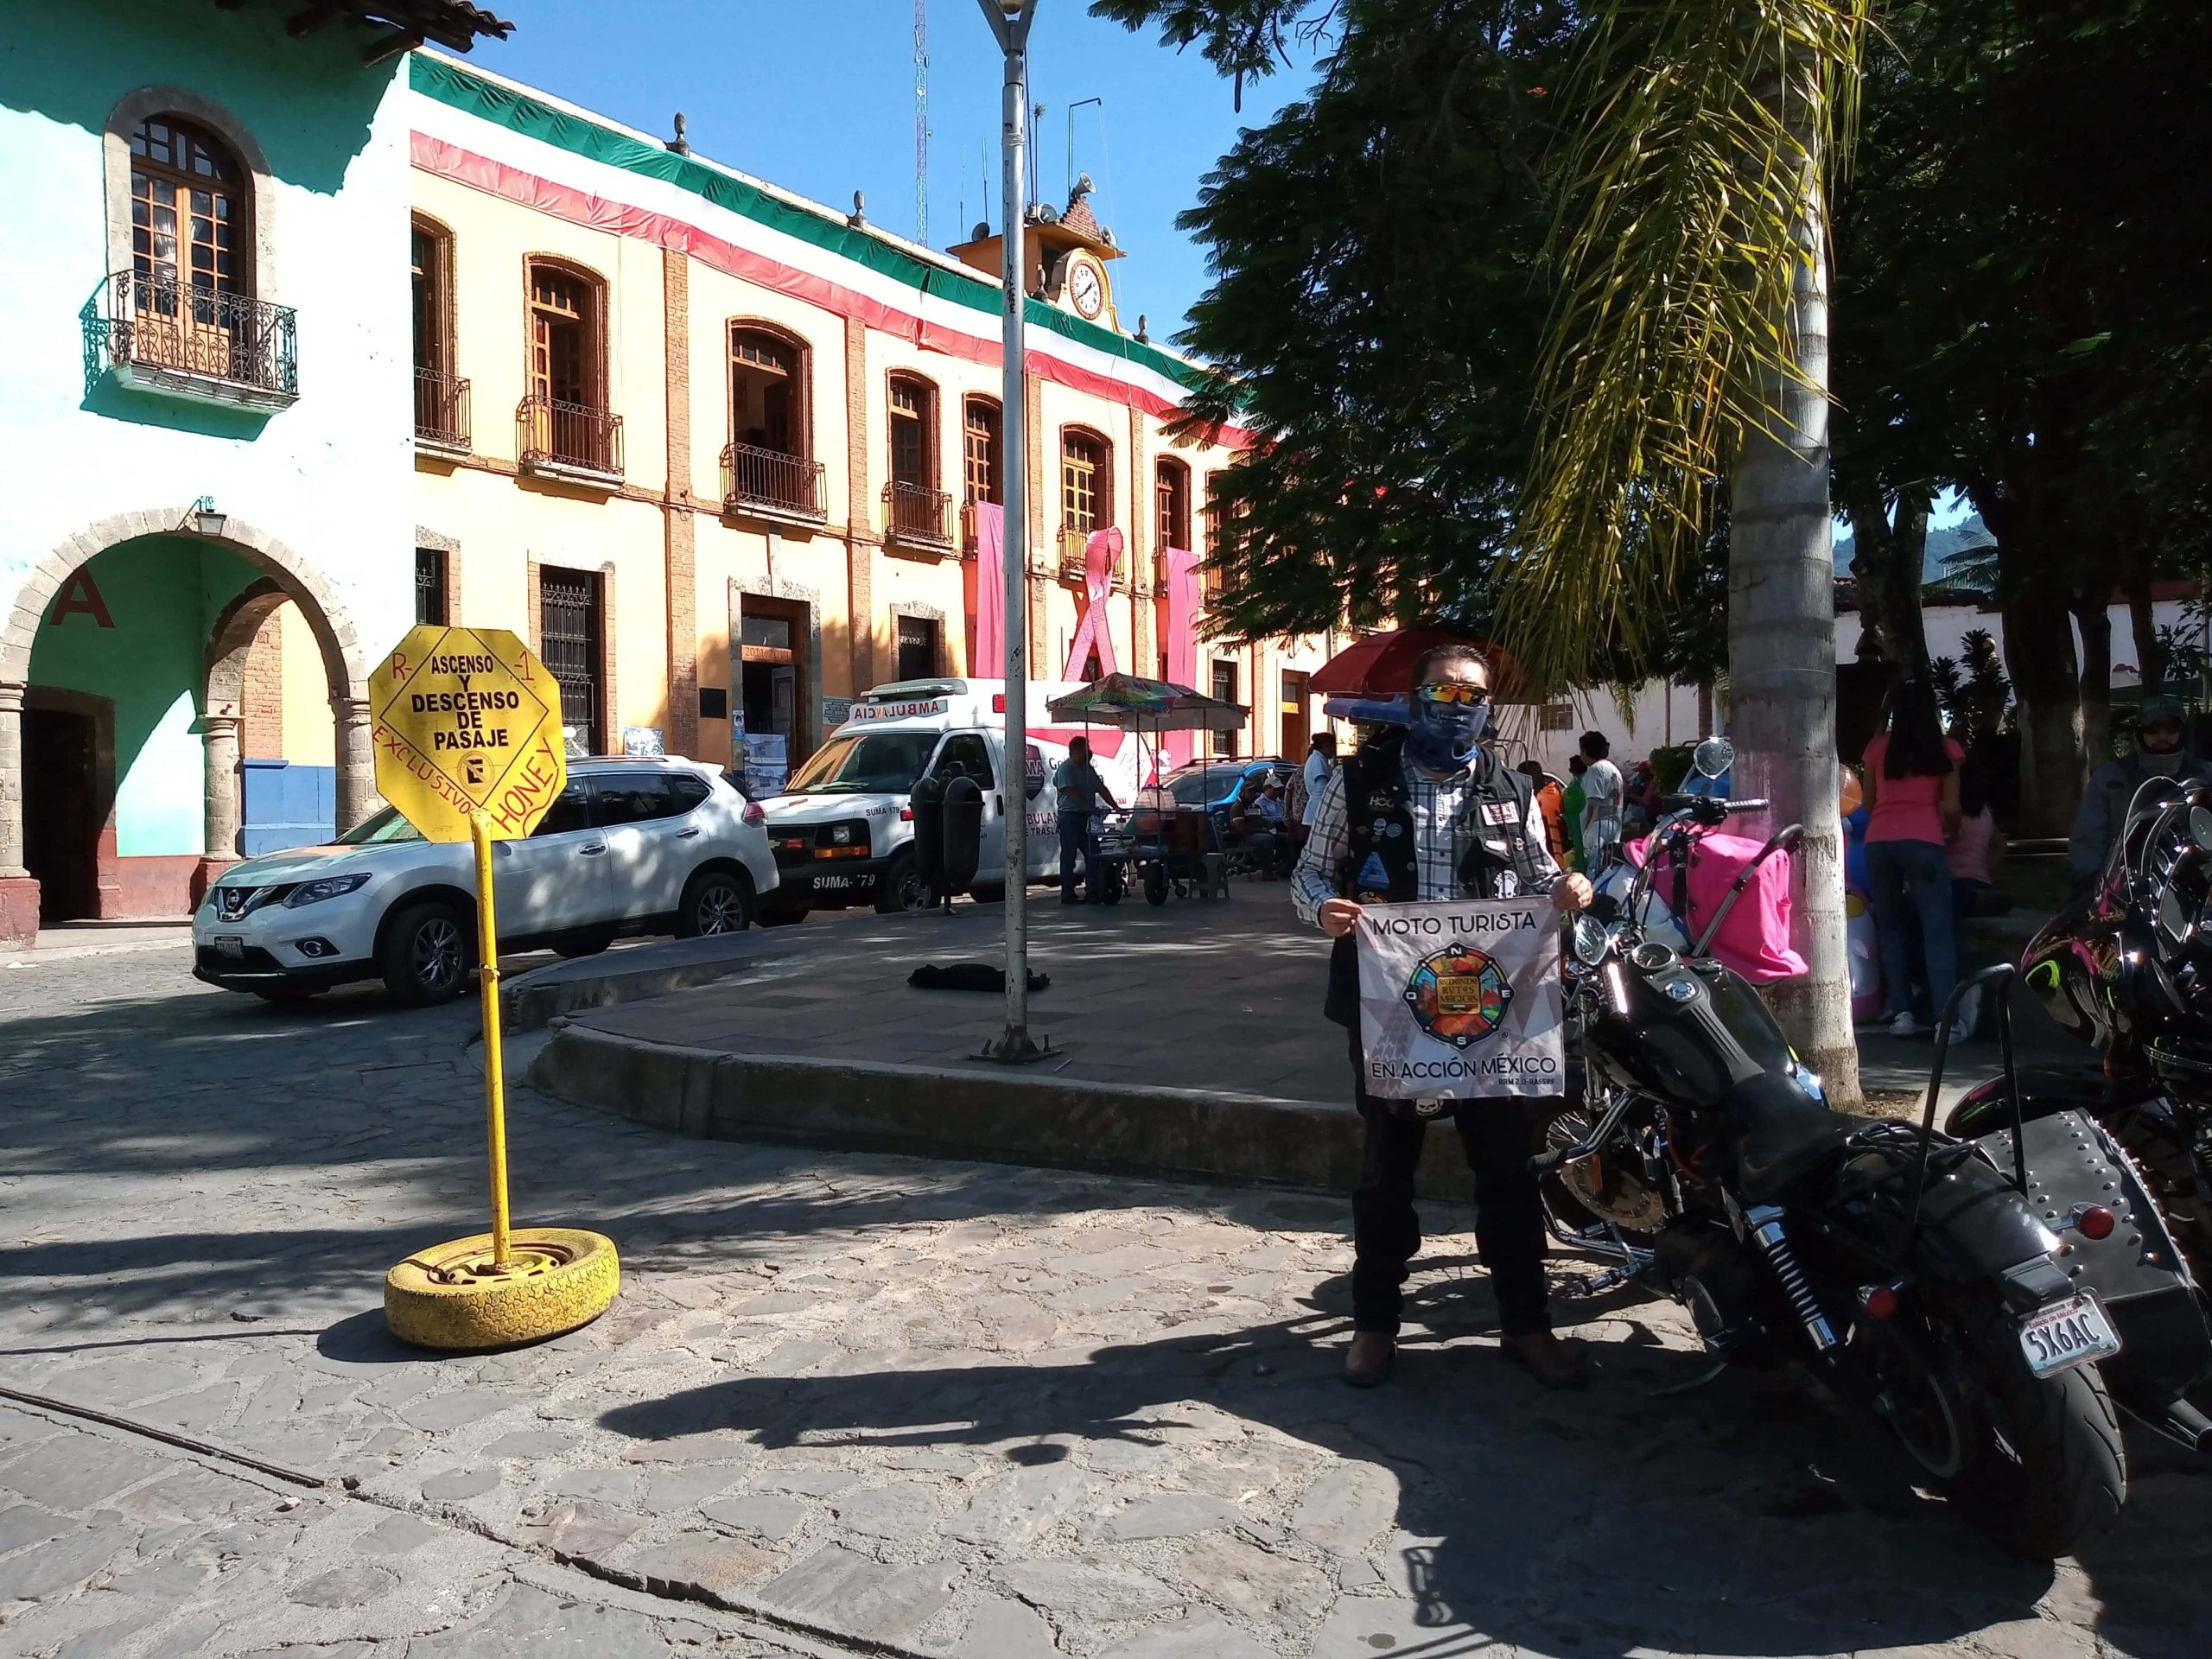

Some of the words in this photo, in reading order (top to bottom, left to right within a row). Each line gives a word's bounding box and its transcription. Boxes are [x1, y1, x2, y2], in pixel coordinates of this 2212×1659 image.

[431, 655, 494, 675] ASCENSO
[458, 675, 472, 692] Y
[411, 691, 520, 713] DESCENSO
[457, 711, 483, 730] DE
[434, 728, 509, 751] PASAJE
[372, 725, 471, 815] EXCLUSIVO
[1025, 760, 1046, 777] MA
[491, 736, 559, 834] HONEY
[889, 806, 900, 815] 179
[1031, 826, 1060, 837] TRASLA
[1372, 918, 1441, 936] MOTO
[1447, 912, 1536, 933] TURISTA
[1450, 947, 1462, 956] N
[1501, 989, 1511, 998] E
[1456, 1036, 1467, 1046] S
[1370, 1061, 1395, 1078] EN
[1402, 1056, 1477, 1079] ACCIÓN
[1480, 1052, 1556, 1074] MÉXICO
[2024, 1313, 2101, 1362] 5X6AC
